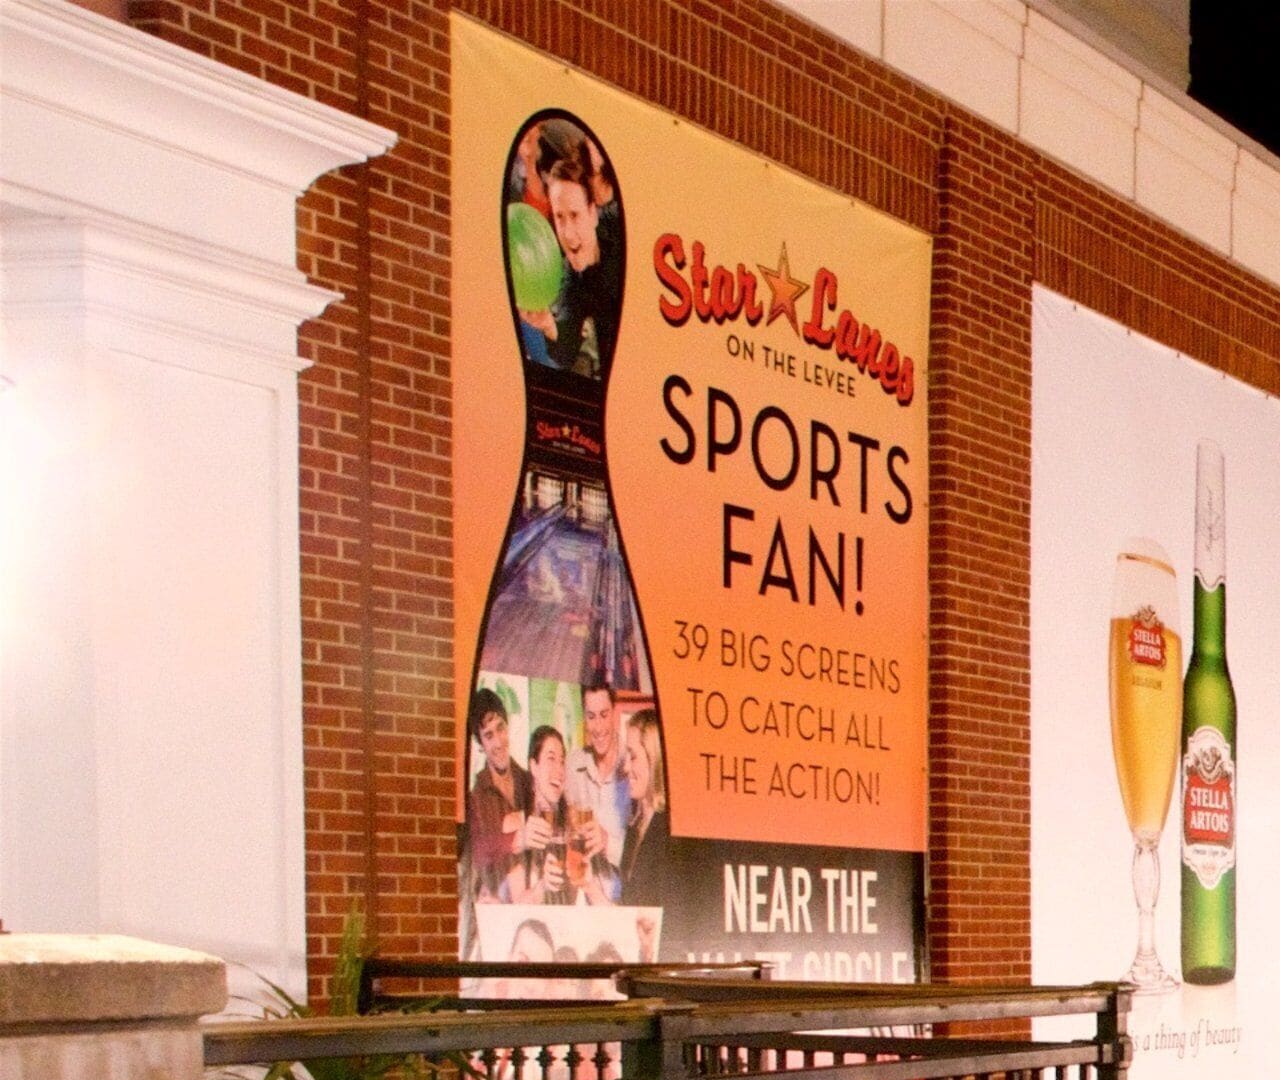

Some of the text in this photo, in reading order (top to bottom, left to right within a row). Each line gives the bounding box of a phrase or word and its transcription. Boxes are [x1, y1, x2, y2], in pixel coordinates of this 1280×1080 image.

[653, 233, 914, 406] Star Lanes
[727, 335, 855, 397] ON THE LEVEE
[660, 375, 913, 525] SPORTS
[723, 503, 864, 616] FAN!
[673, 620, 900, 694] 39 BIG SCREENS
[1133, 626, 1161, 647] STELLA
[1133, 643, 1161, 660] ARTOIS
[687, 688, 890, 750] TO CATCH ALL
[700, 753, 879, 805] THE ACTION!
[1190, 787, 1228, 810] STELLA
[1190, 810, 1229, 833] ARTOIS
[724, 864, 878, 934] NEAR THE
[1142, 1034, 1151, 1052] a
[1155, 1022, 1187, 1060] thing
[1189, 1018, 1204, 1059] of
[1205, 1019, 1243, 1054] beauty
